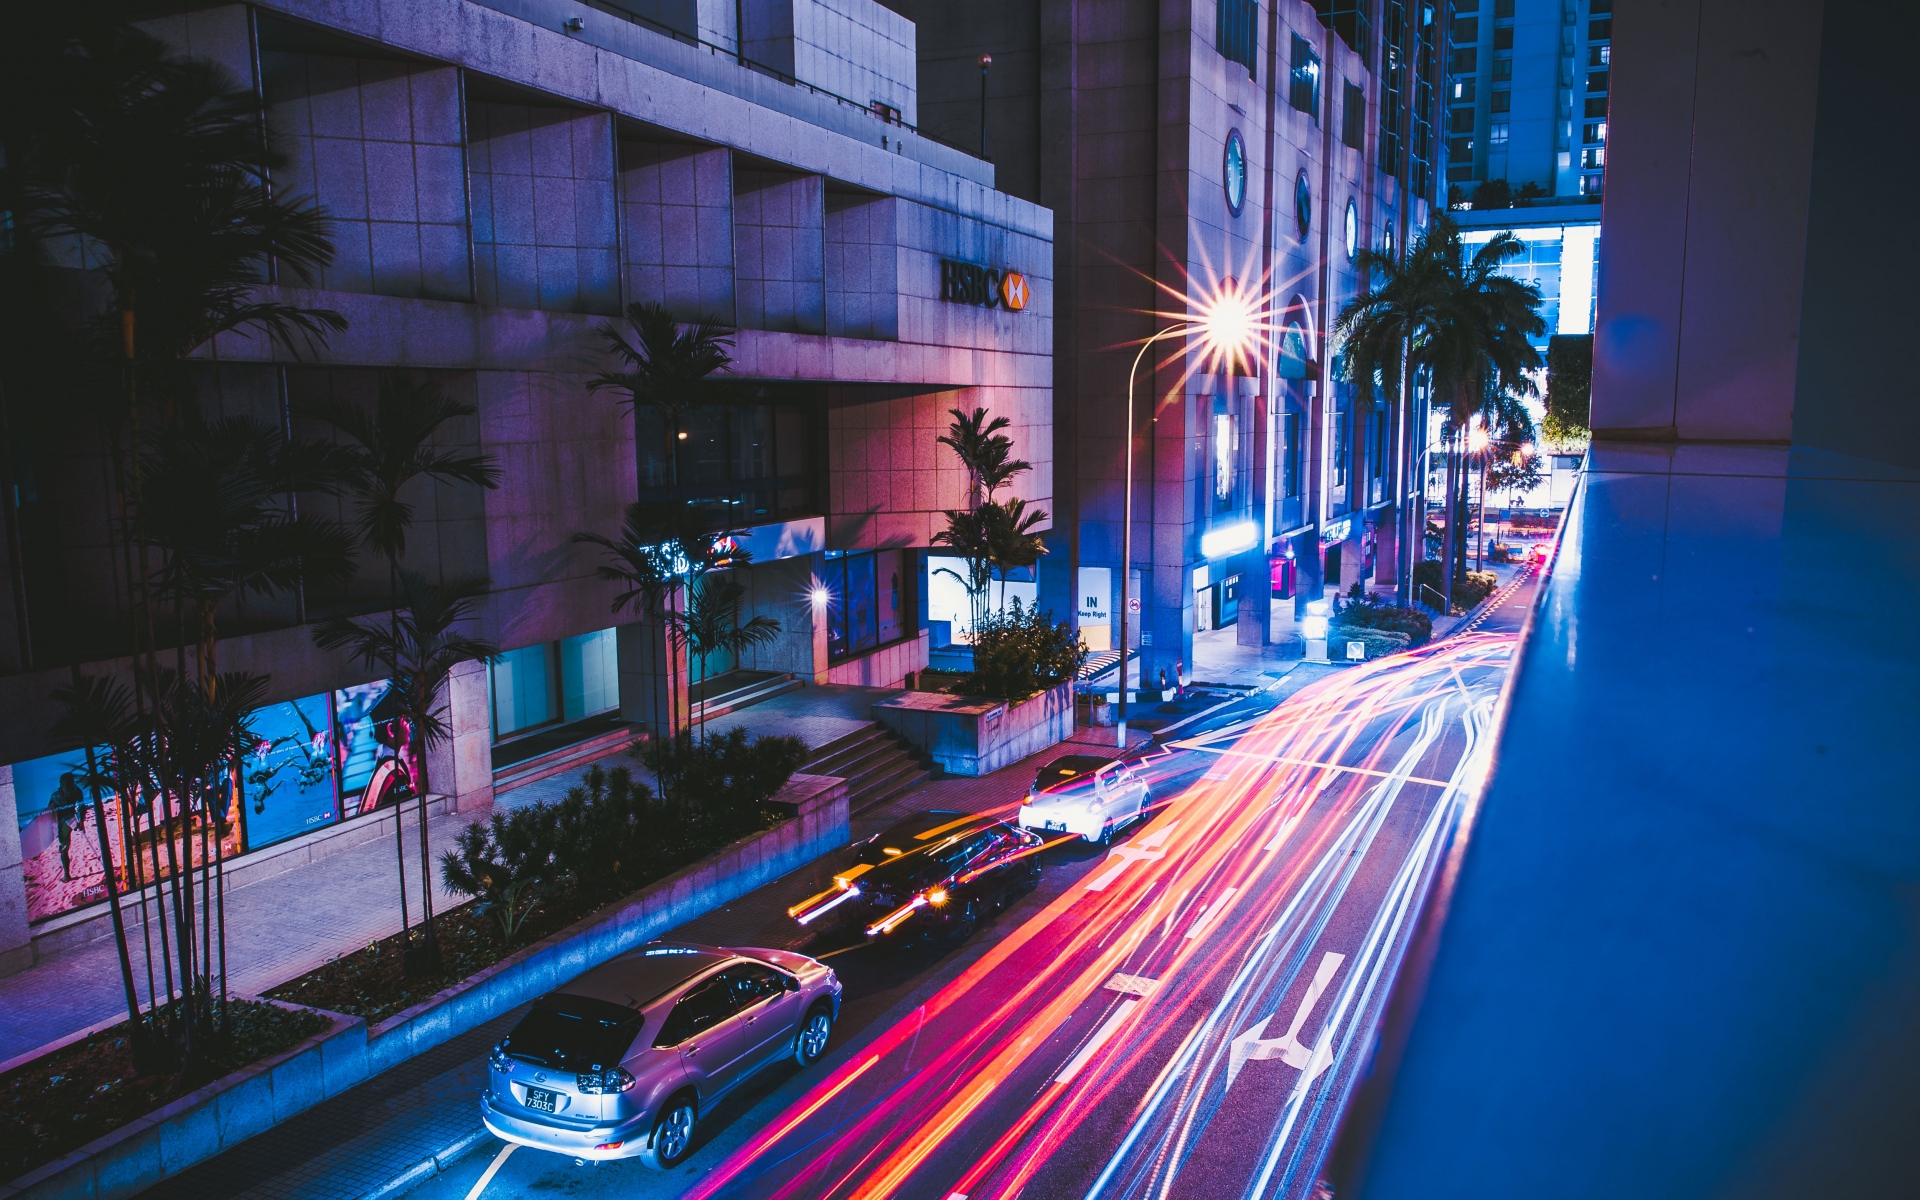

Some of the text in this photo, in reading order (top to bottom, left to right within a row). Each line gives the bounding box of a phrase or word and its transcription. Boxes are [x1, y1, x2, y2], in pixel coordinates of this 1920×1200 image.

[940, 258, 999, 309] HSBC
[1086, 596, 1097, 608] IN
[1077, 610, 1091, 618] Keep
[306, 814, 322, 825] HSBC
[83, 884, 105, 898] HSBC
[533, 1090, 549, 1102] SFY
[527, 1097, 553, 1112] 7303C
